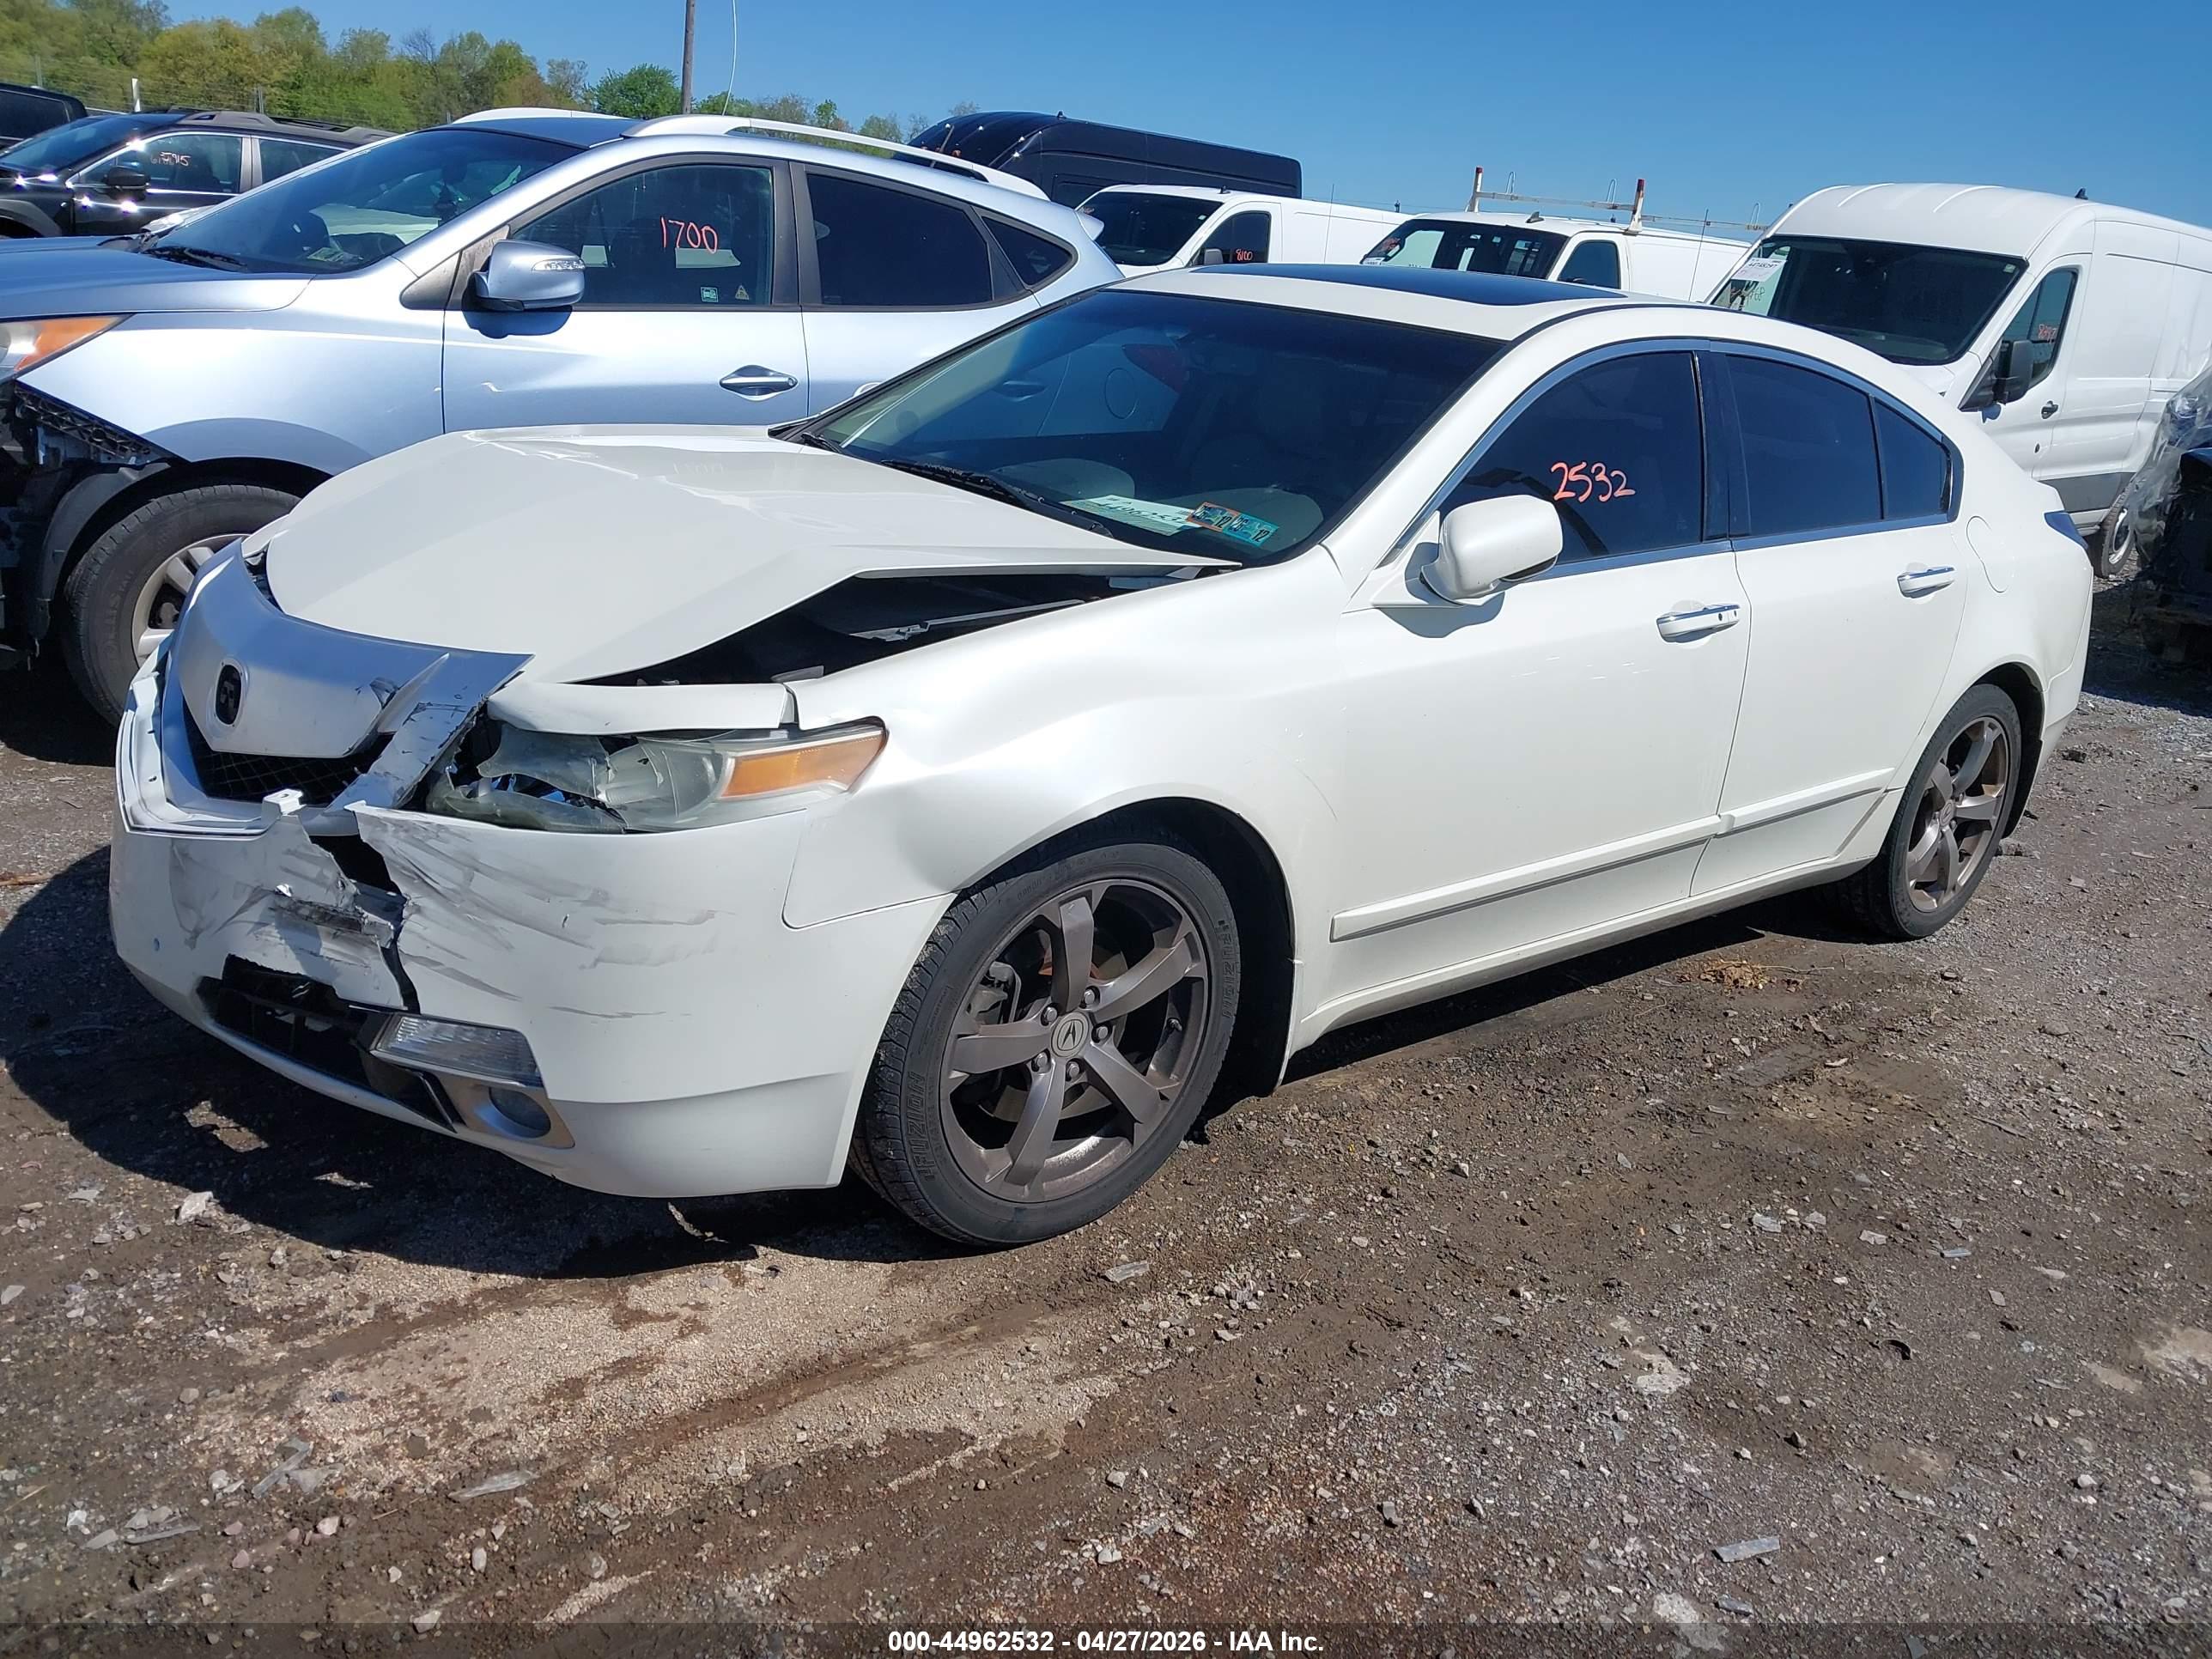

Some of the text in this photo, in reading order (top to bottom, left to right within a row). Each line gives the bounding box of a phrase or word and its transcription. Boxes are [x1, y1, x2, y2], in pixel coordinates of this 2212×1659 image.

[660, 216, 718, 254] 1700
[1551, 461, 1636, 502] 2532
[1214, 515, 1232, 529] 12
[1252, 529, 1270, 543] 12
[907, 1071, 935, 1181] FUZION
